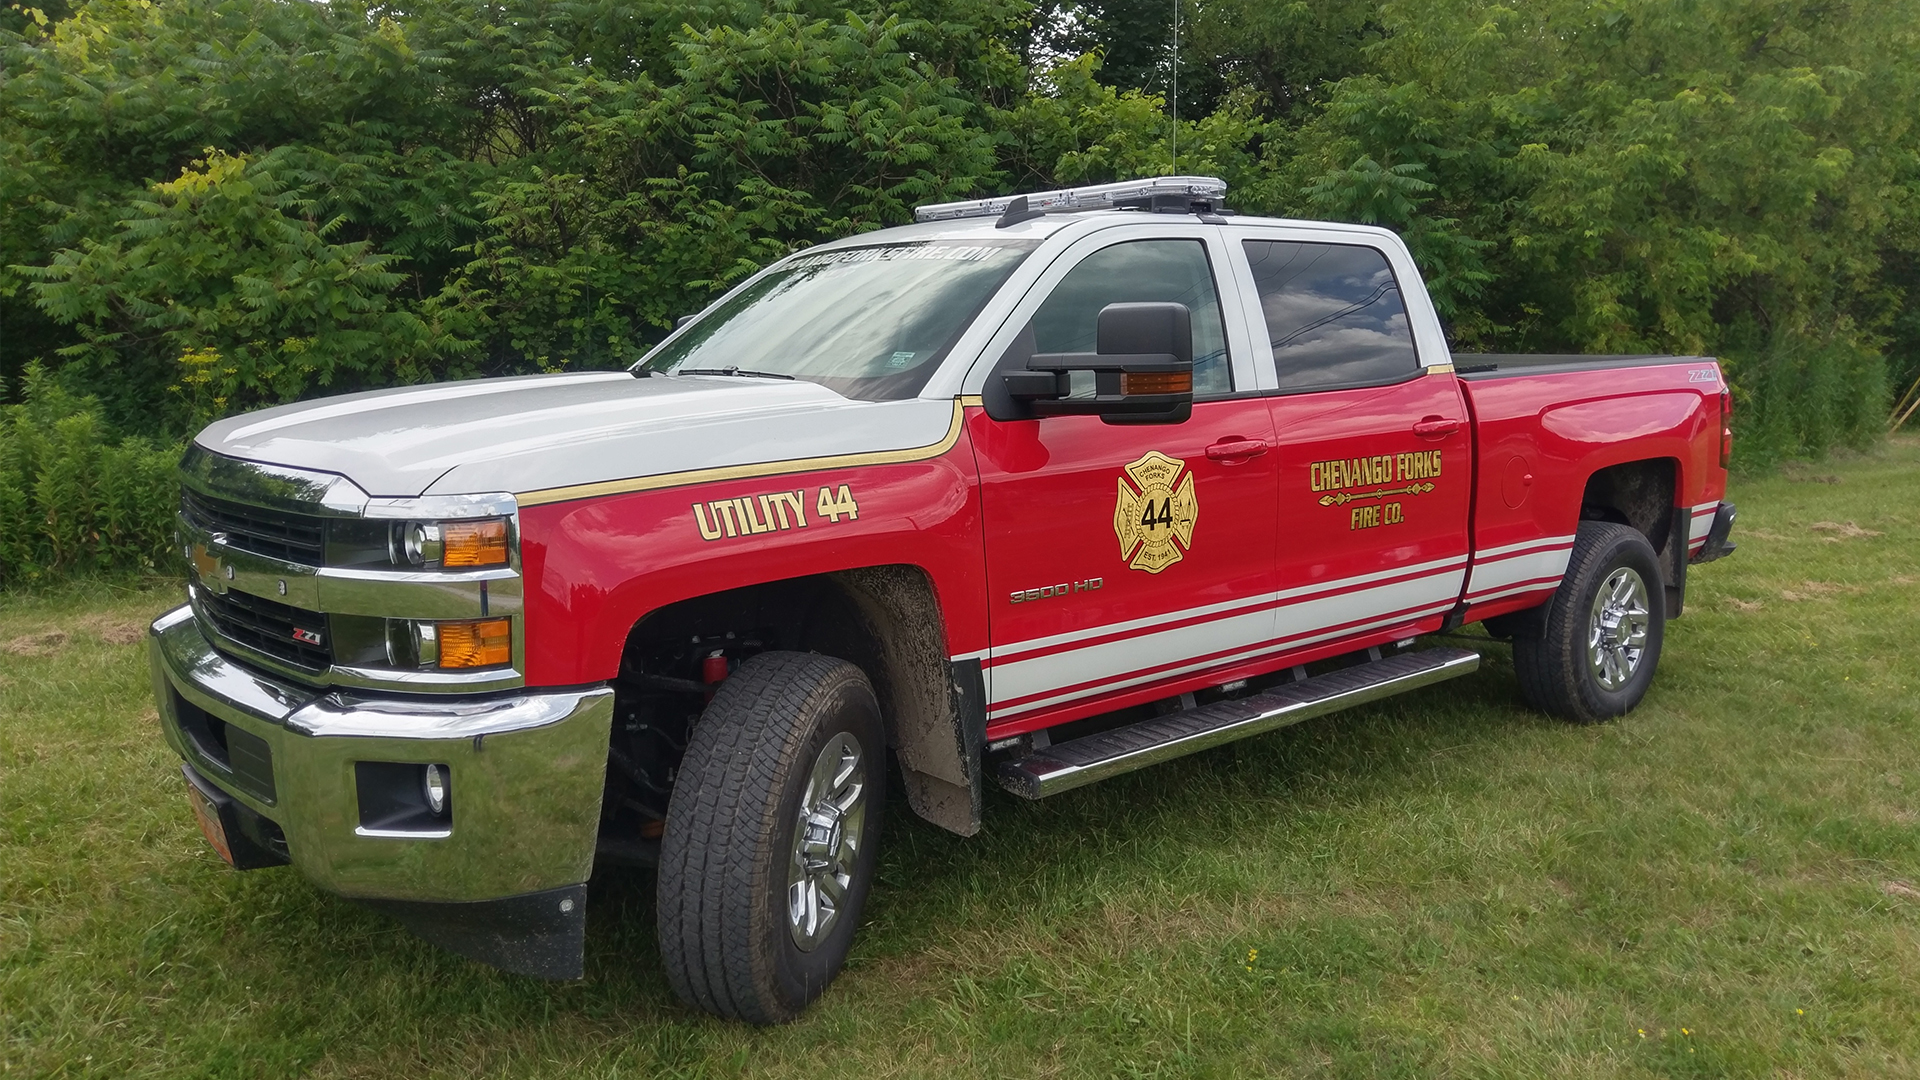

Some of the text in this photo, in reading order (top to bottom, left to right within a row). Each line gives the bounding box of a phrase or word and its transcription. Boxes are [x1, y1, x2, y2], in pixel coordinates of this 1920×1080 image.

[1688, 369, 1718, 383] Z71
[1139, 464, 1170, 477] CHENANGO
[1145, 472, 1165, 481] FORKS
[1310, 450, 1442, 492] CHENANGO FORKS
[691, 484, 859, 541] UTILITY 44
[1141, 497, 1173, 531] 44
[1350, 502, 1405, 531] FIRE CO.
[1143, 549, 1171, 562] EST. 1941
[1010, 577, 1103, 604] 3500 HD
[292, 627, 321, 646] Z71
